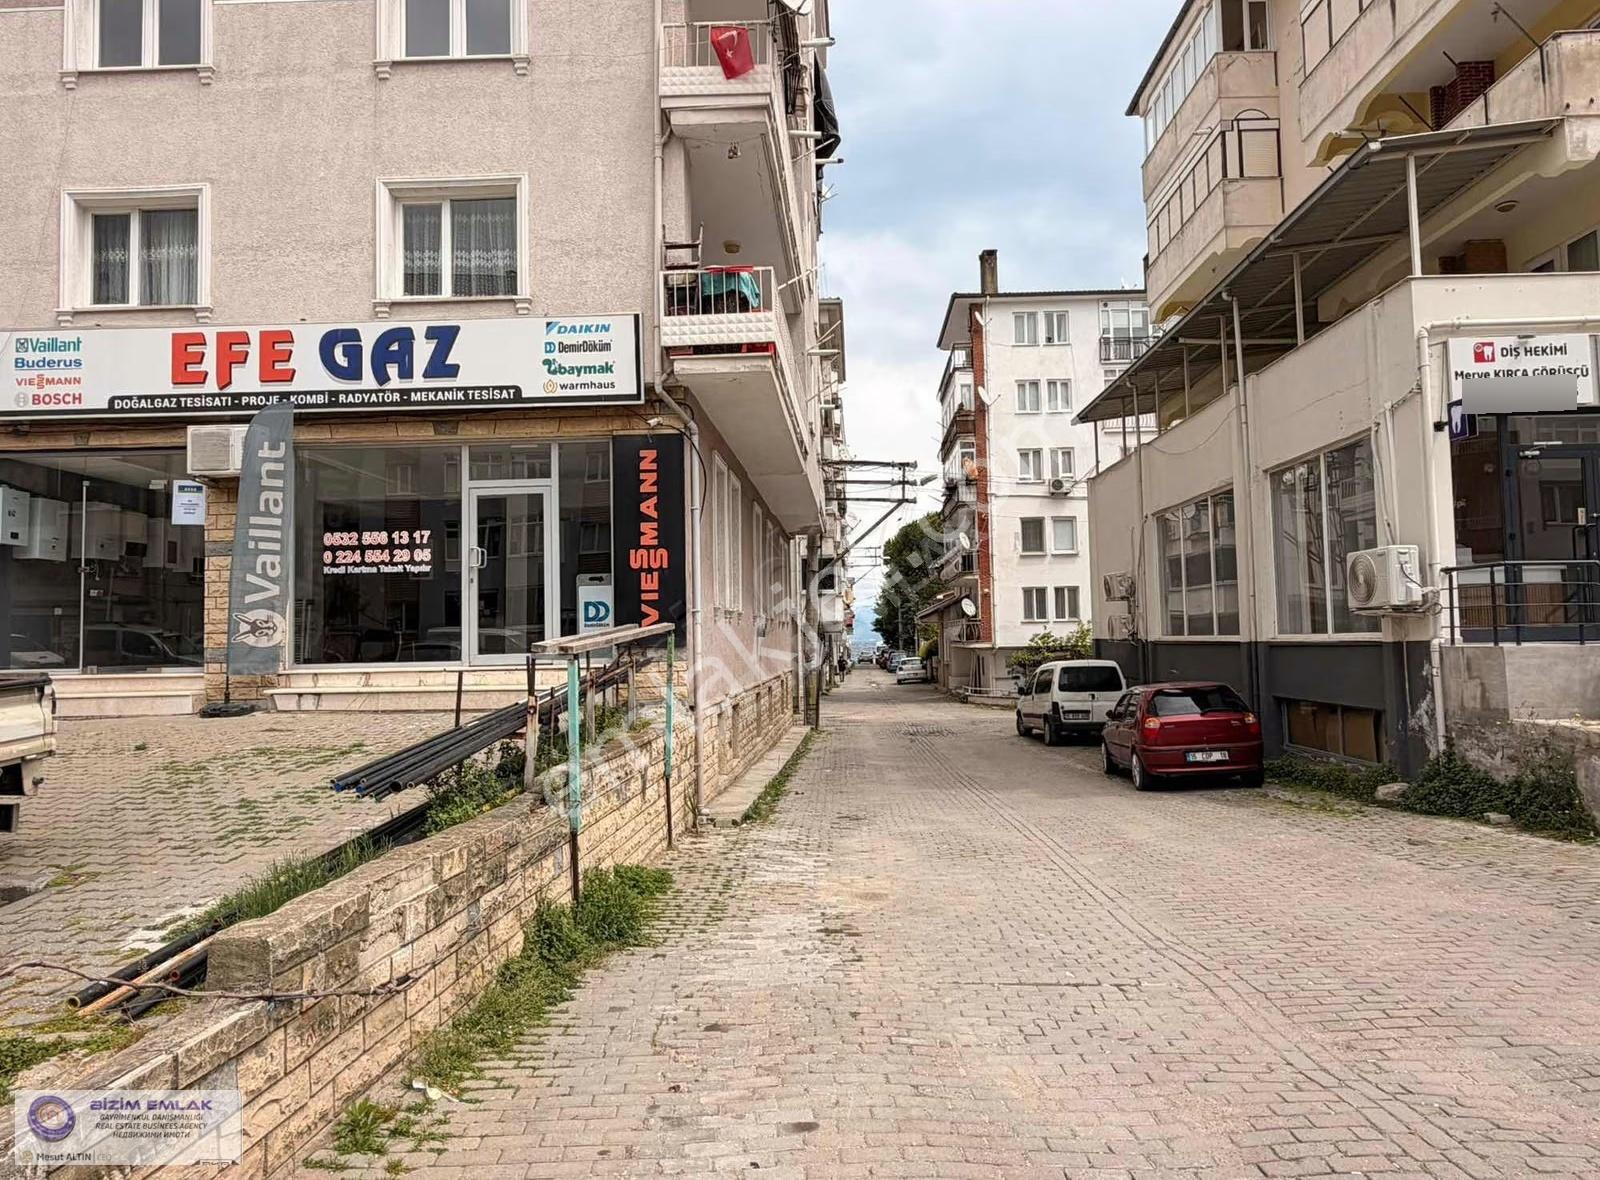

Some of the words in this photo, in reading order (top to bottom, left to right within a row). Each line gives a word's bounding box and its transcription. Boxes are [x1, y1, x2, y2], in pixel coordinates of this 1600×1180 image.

[557, 323, 611, 335] DAIKIN
[29, 336, 83, 353] Vaillant
[558, 340, 612, 353] DemirDöküm
[1500, 344, 1521, 359] DİŞ
[1524, 342, 1568, 357] HEKİMİ
[14, 357, 83, 369] Buderus
[171, 329, 296, 390] EFE
[318, 325, 461, 387] GAZ
[559, 361, 614, 377] baymak
[559, 381, 616, 391] warmhaus
[31, 392, 83, 406] BOSCH
[114, 397, 177, 409] DOĞALGAZ
[180, 395, 231, 408] TESİSATI
[339, 390, 401, 404] RADYATÖR
[411, 388, 465, 402] MEKANİK
[467, 387, 516, 400] TESİSAT
[244, 440, 286, 605] Vaillant
[392, 531, 410, 545] 13
[413, 530, 431, 544] 17
[629, 449, 669, 628] VIESSMANN
[323, 550, 333, 564] 0
